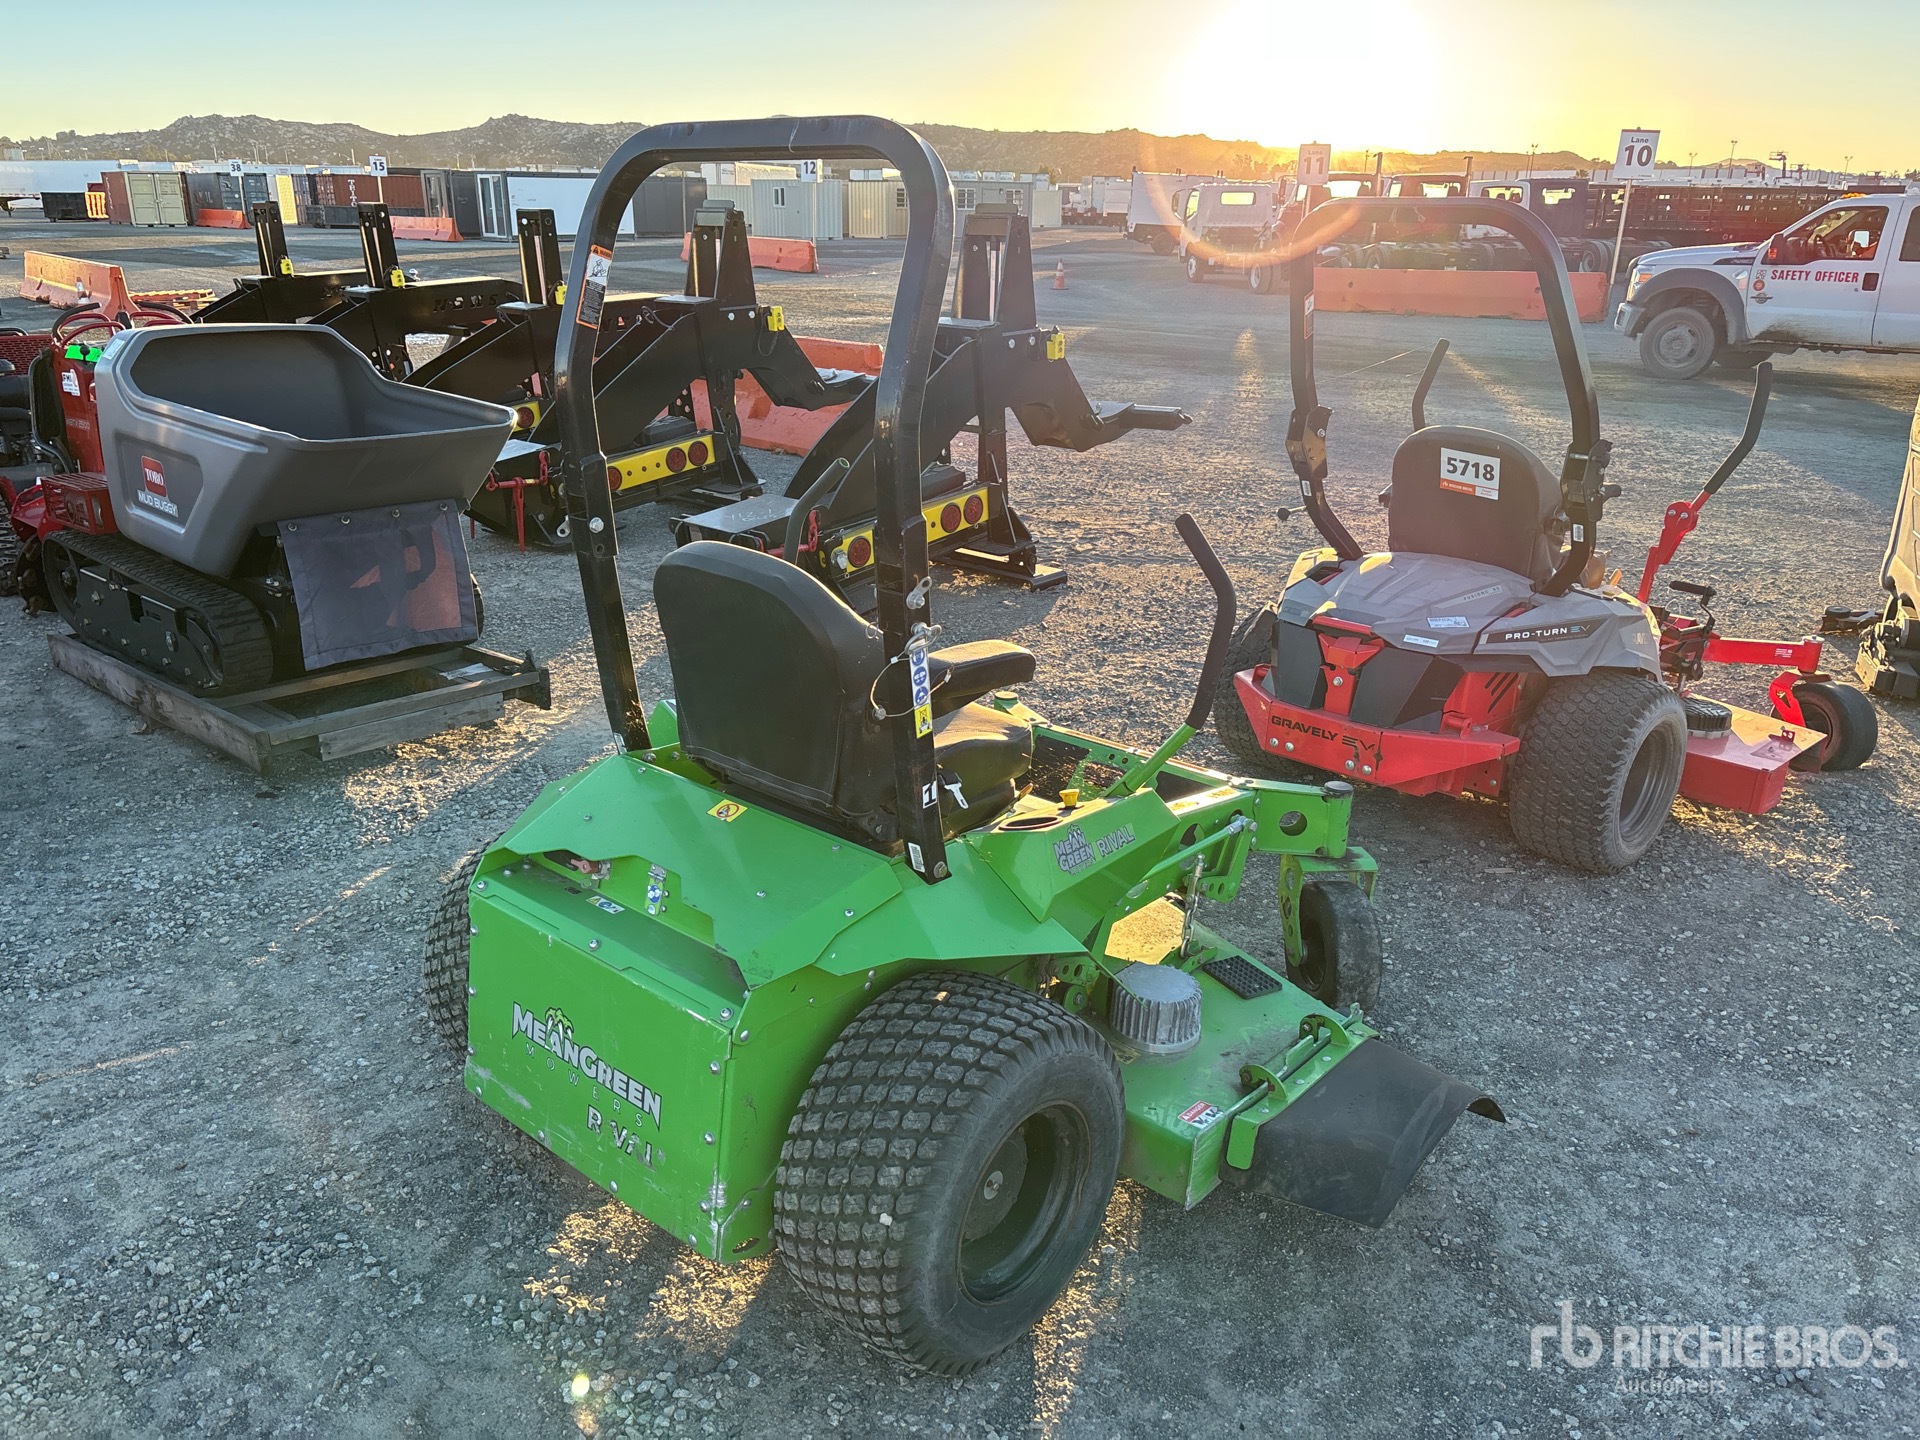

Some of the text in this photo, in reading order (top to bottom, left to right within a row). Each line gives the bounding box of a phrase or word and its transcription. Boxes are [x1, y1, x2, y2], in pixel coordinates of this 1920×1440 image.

[1304, 157, 1324, 175] 11
[1624, 145, 1652, 167] 10
[230, 164, 242, 172] 38
[372, 161, 385, 172] 15
[803, 161, 816, 175] 12
[1771, 269, 1811, 282] SAFETY
[1814, 271, 1860, 284] OFFICER
[144, 467, 164, 486] TORO
[1446, 456, 1495, 481] 5718
[138, 491, 177, 516] MUD BUGGY
[1505, 627, 1568, 641] PRO-TURN
[1570, 624, 1591, 633] EV
[1271, 715, 1338, 741] GRAVELY
[1053, 826, 1136, 860] MEAN RIVAL
[1058, 843, 1097, 872] GREEN
[525, 1043, 643, 1127] MOWERS
